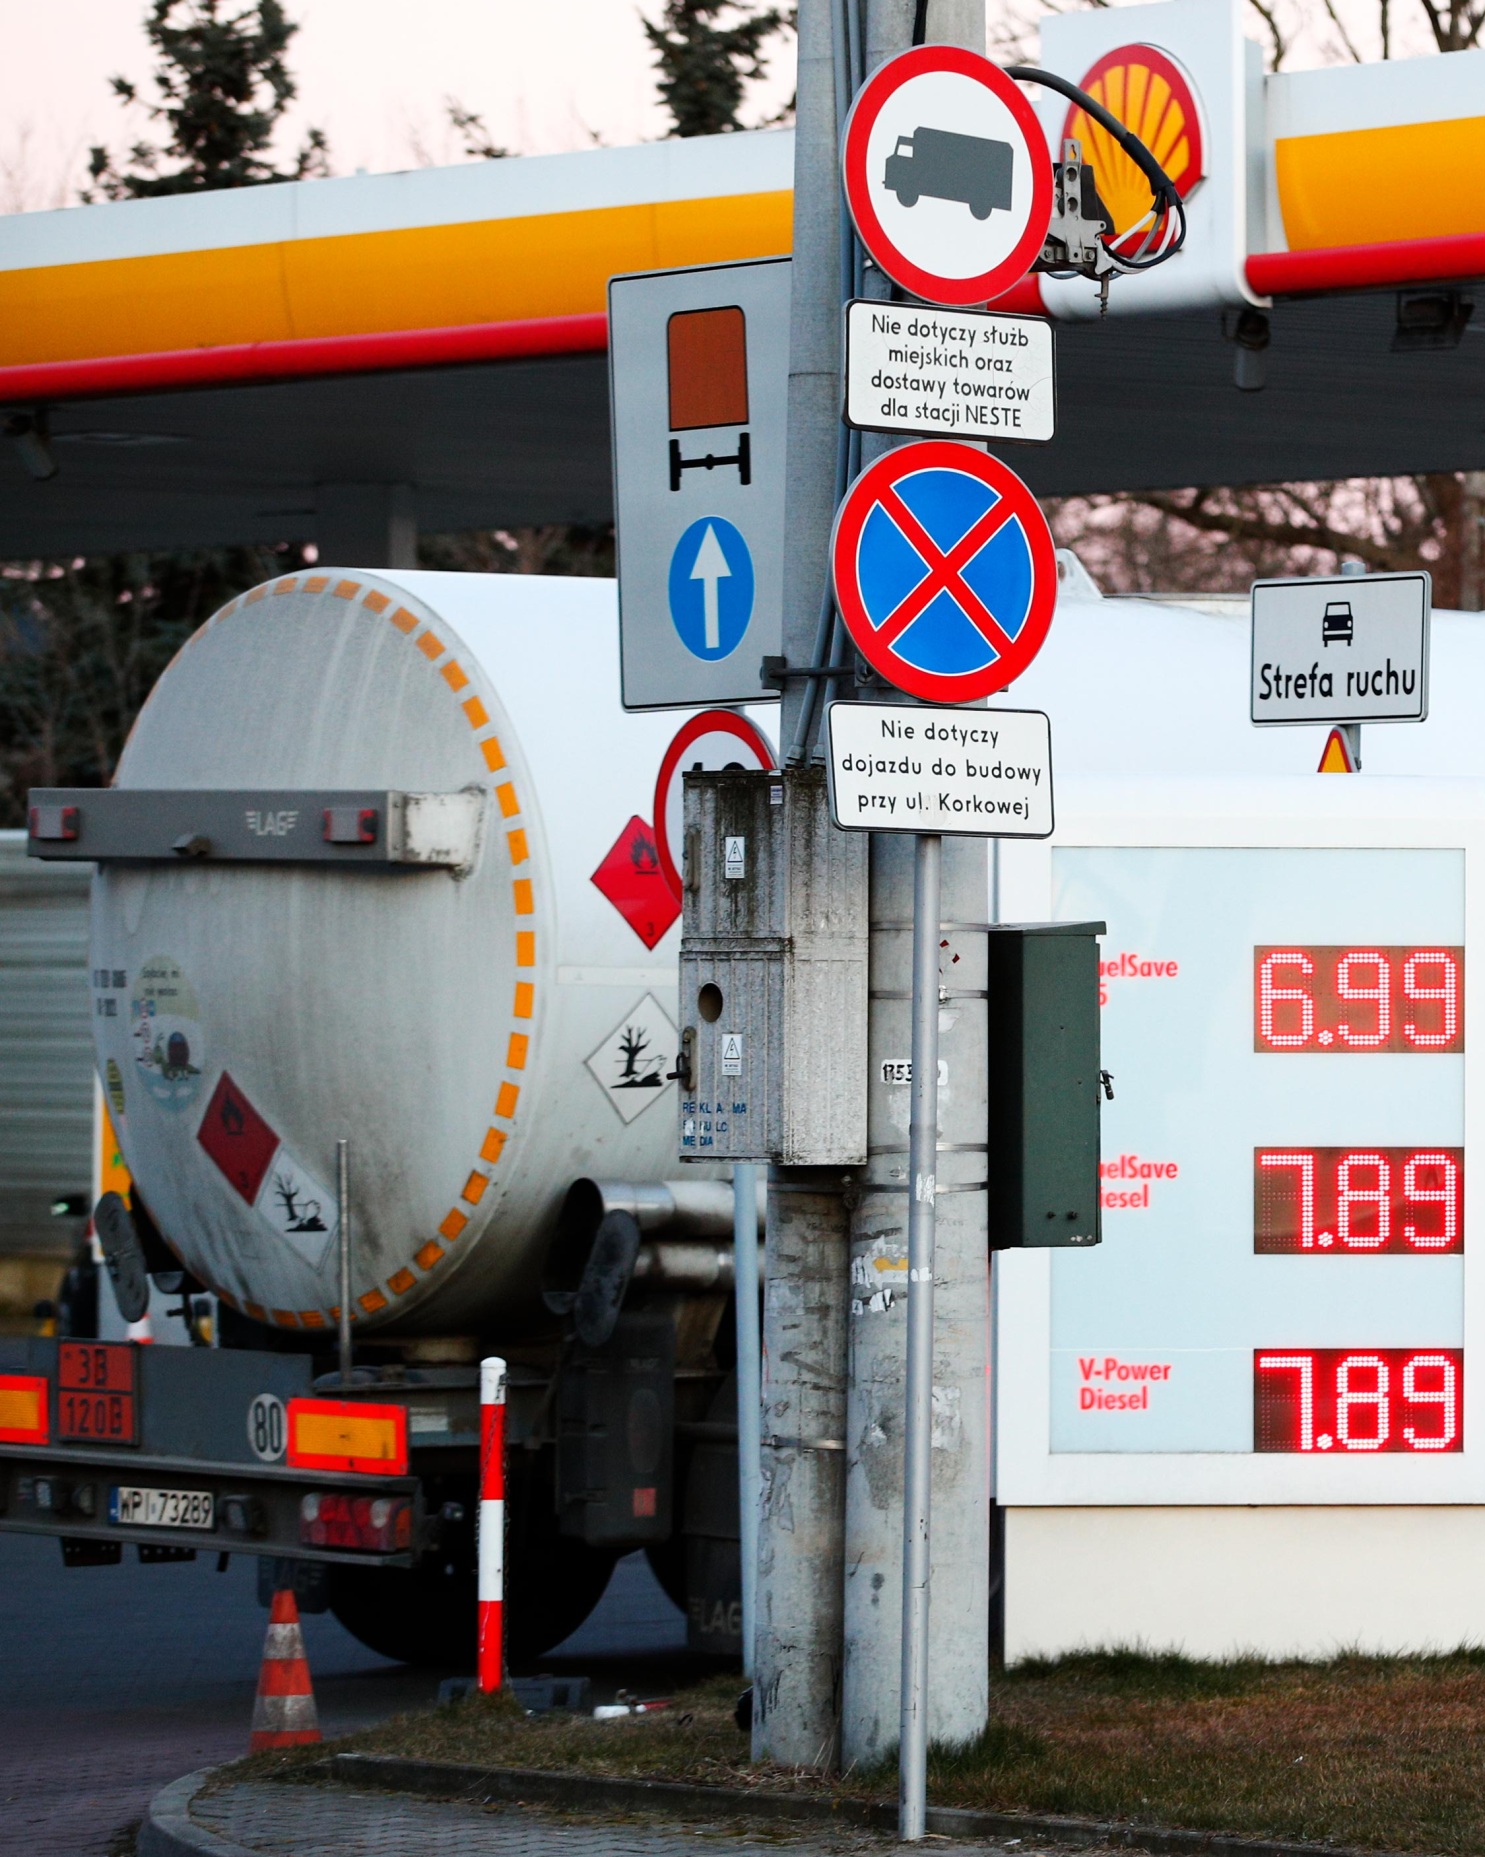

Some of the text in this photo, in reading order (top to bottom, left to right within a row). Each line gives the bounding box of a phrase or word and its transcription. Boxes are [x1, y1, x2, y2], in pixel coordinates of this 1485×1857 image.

[872, 314, 1029, 347] Nie dotyczy służb
[889, 345, 1012, 372] miejskich oraz
[871, 370, 1030, 400] dostawy towarów
[881, 398, 1021, 427] dla stacji NESTE
[1259, 658, 1415, 700] Strefa ruchu
[881, 720, 999, 748] Nie dotyczy
[842, 754, 1041, 785] dojazdu do budowy
[858, 792, 1029, 819] przy ul. Korkowej
[646, 922, 654, 936] 3
[1098, 953, 1178, 977] uelSave
[1261, 953, 1456, 1046] 6.99
[1098, 1155, 1178, 1178] uelSave
[1099, 1184, 1148, 1208] iesel
[1260, 1154, 1456, 1248] 7.89
[1079, 1358, 1171, 1380] V-Power
[1081, 1386, 1147, 1410] Diesel
[1260, 1356, 1455, 1450] 7.89
[253, 1400, 283, 1454] 80
[158, 1492, 211, 1524] 73289
